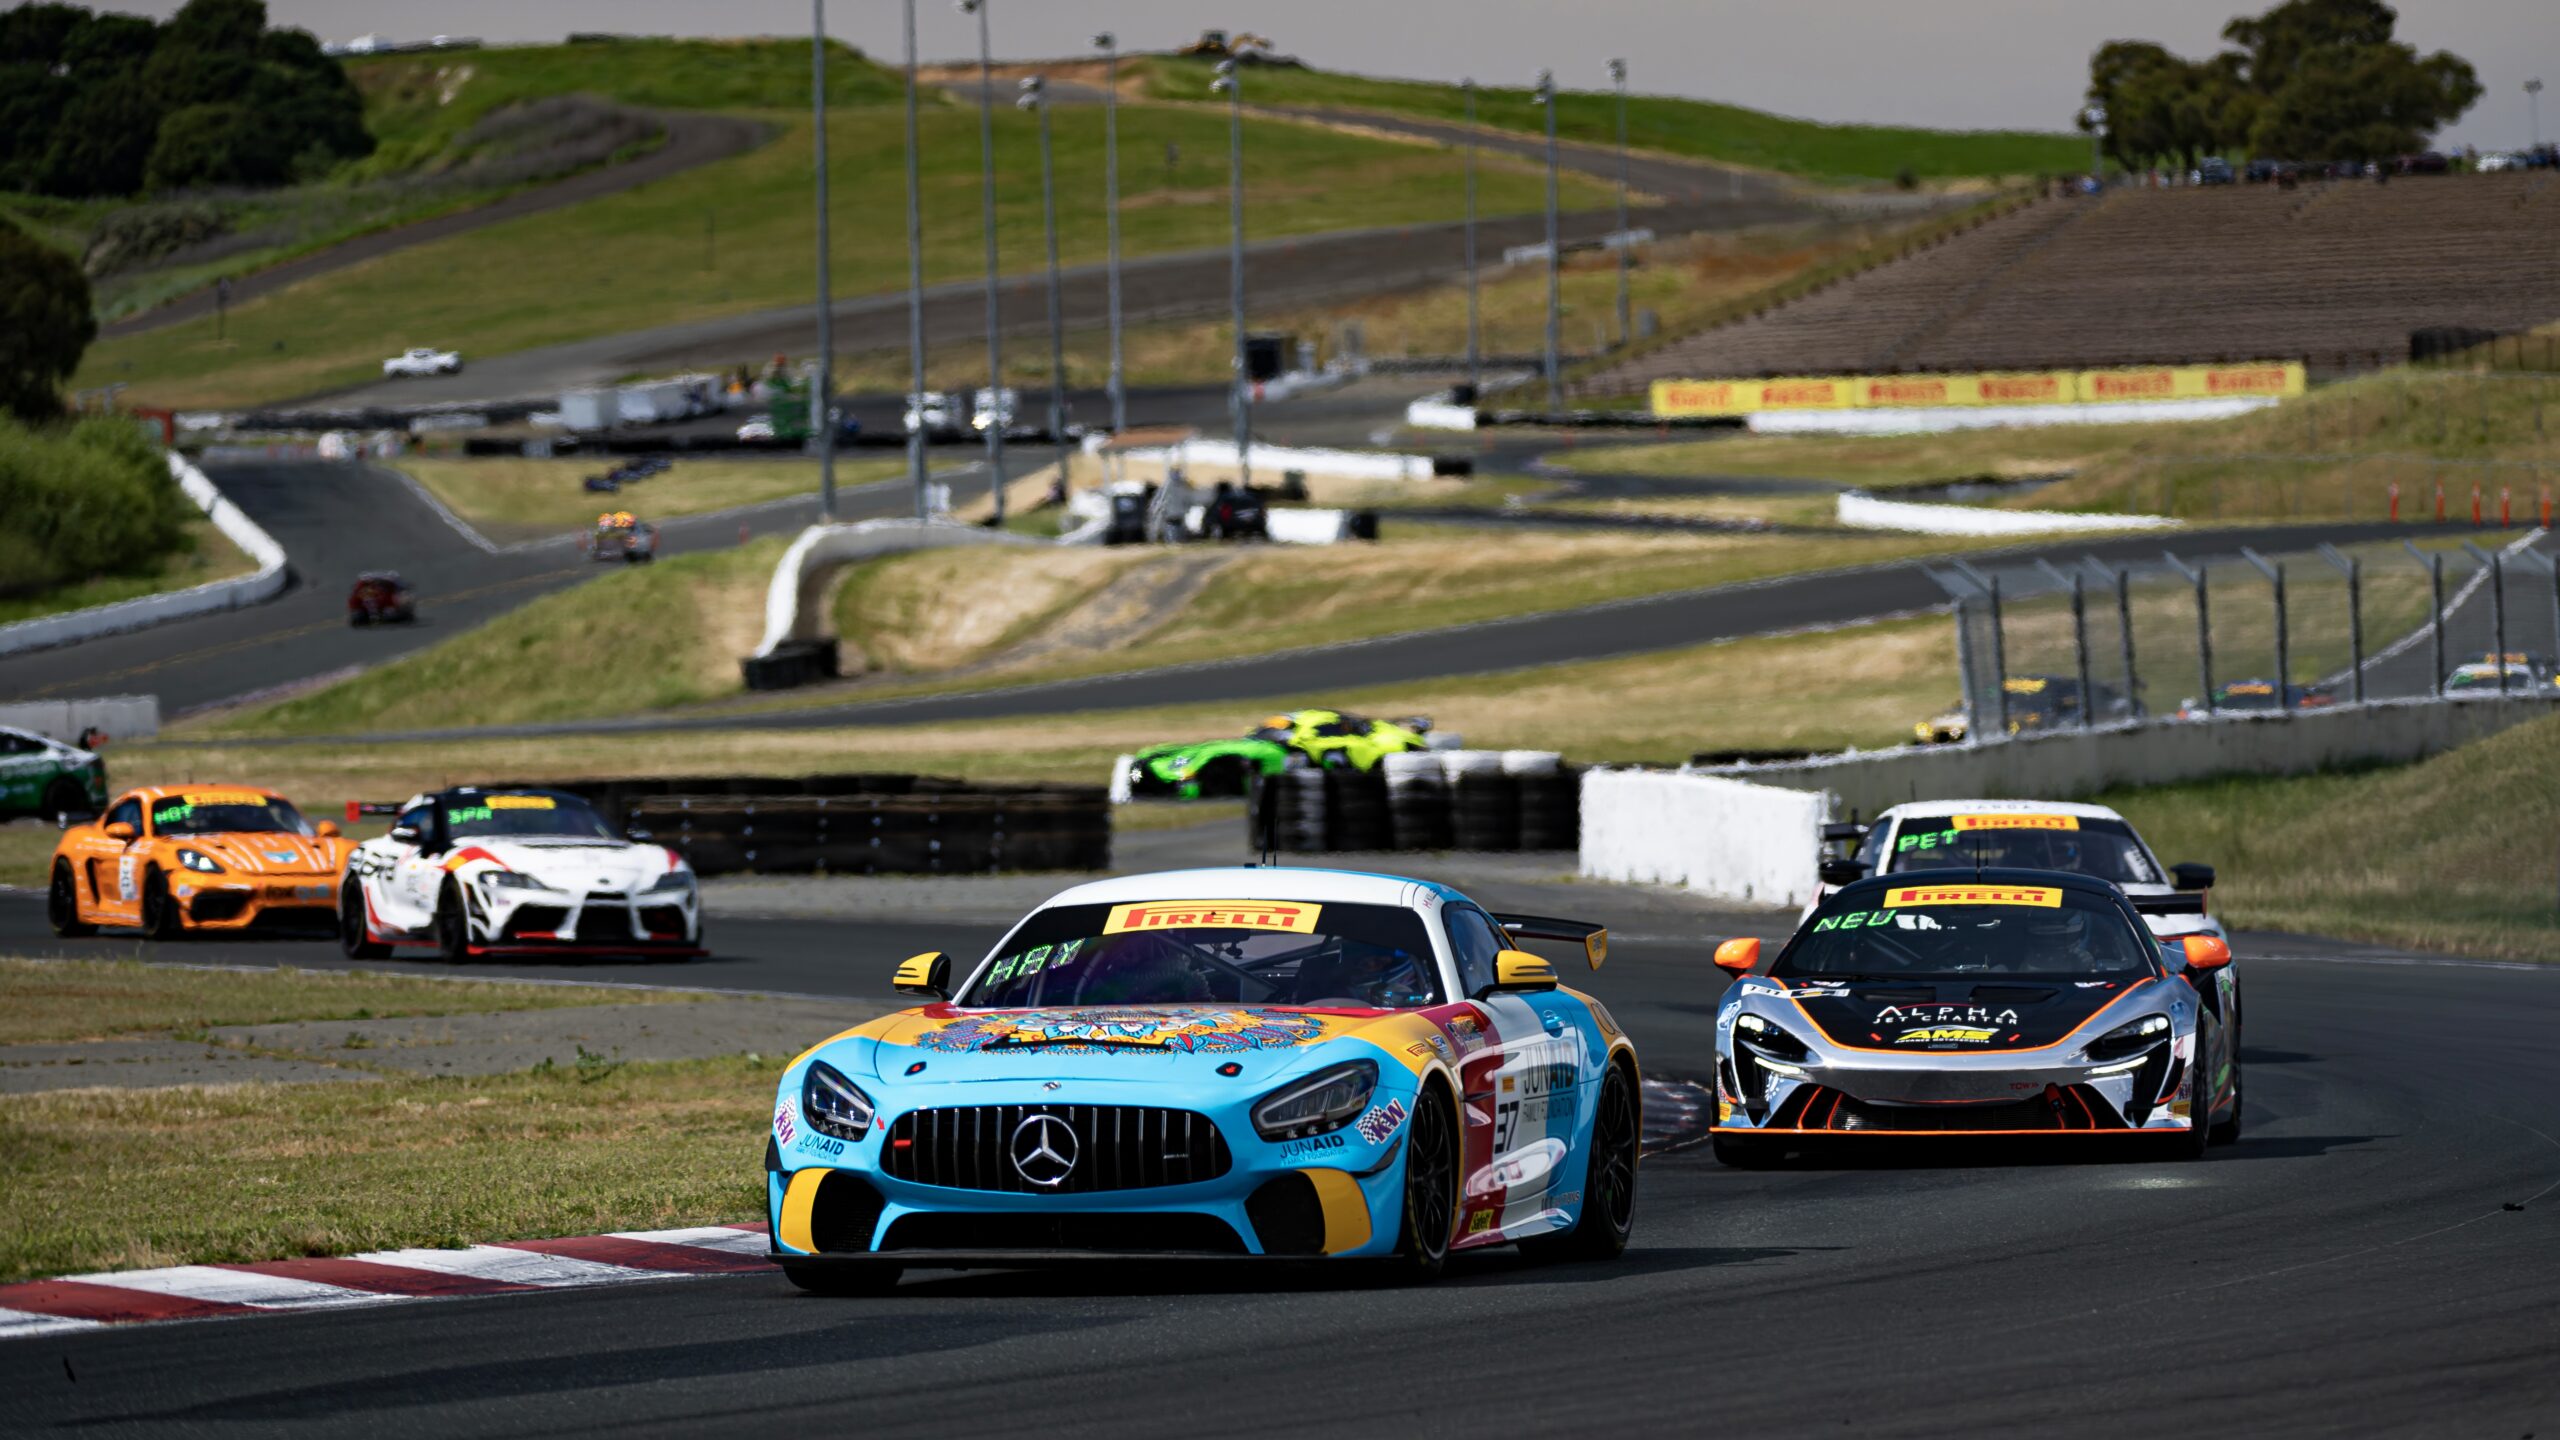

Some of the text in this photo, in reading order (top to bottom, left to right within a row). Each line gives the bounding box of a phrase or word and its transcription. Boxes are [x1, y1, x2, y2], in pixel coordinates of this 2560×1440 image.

[1899, 829, 1961, 852] PET
[1900, 889, 2046, 902] PIRELLI
[1123, 905, 1301, 929] PIRELLI
[1813, 910, 1897, 933] NEU
[985, 938, 1085, 987] HAY
[1873, 1015, 2017, 1025] JET CHARTER
[1876, 1006, 2018, 1018] ALPHA
[1897, 1029, 1995, 1041] AMS
[1370, 1099, 1406, 1142] KW
[1494, 1100, 1520, 1155] 37
[799, 1133, 845, 1156] JUNAID
[1280, 1135, 1345, 1159] JUNAID
